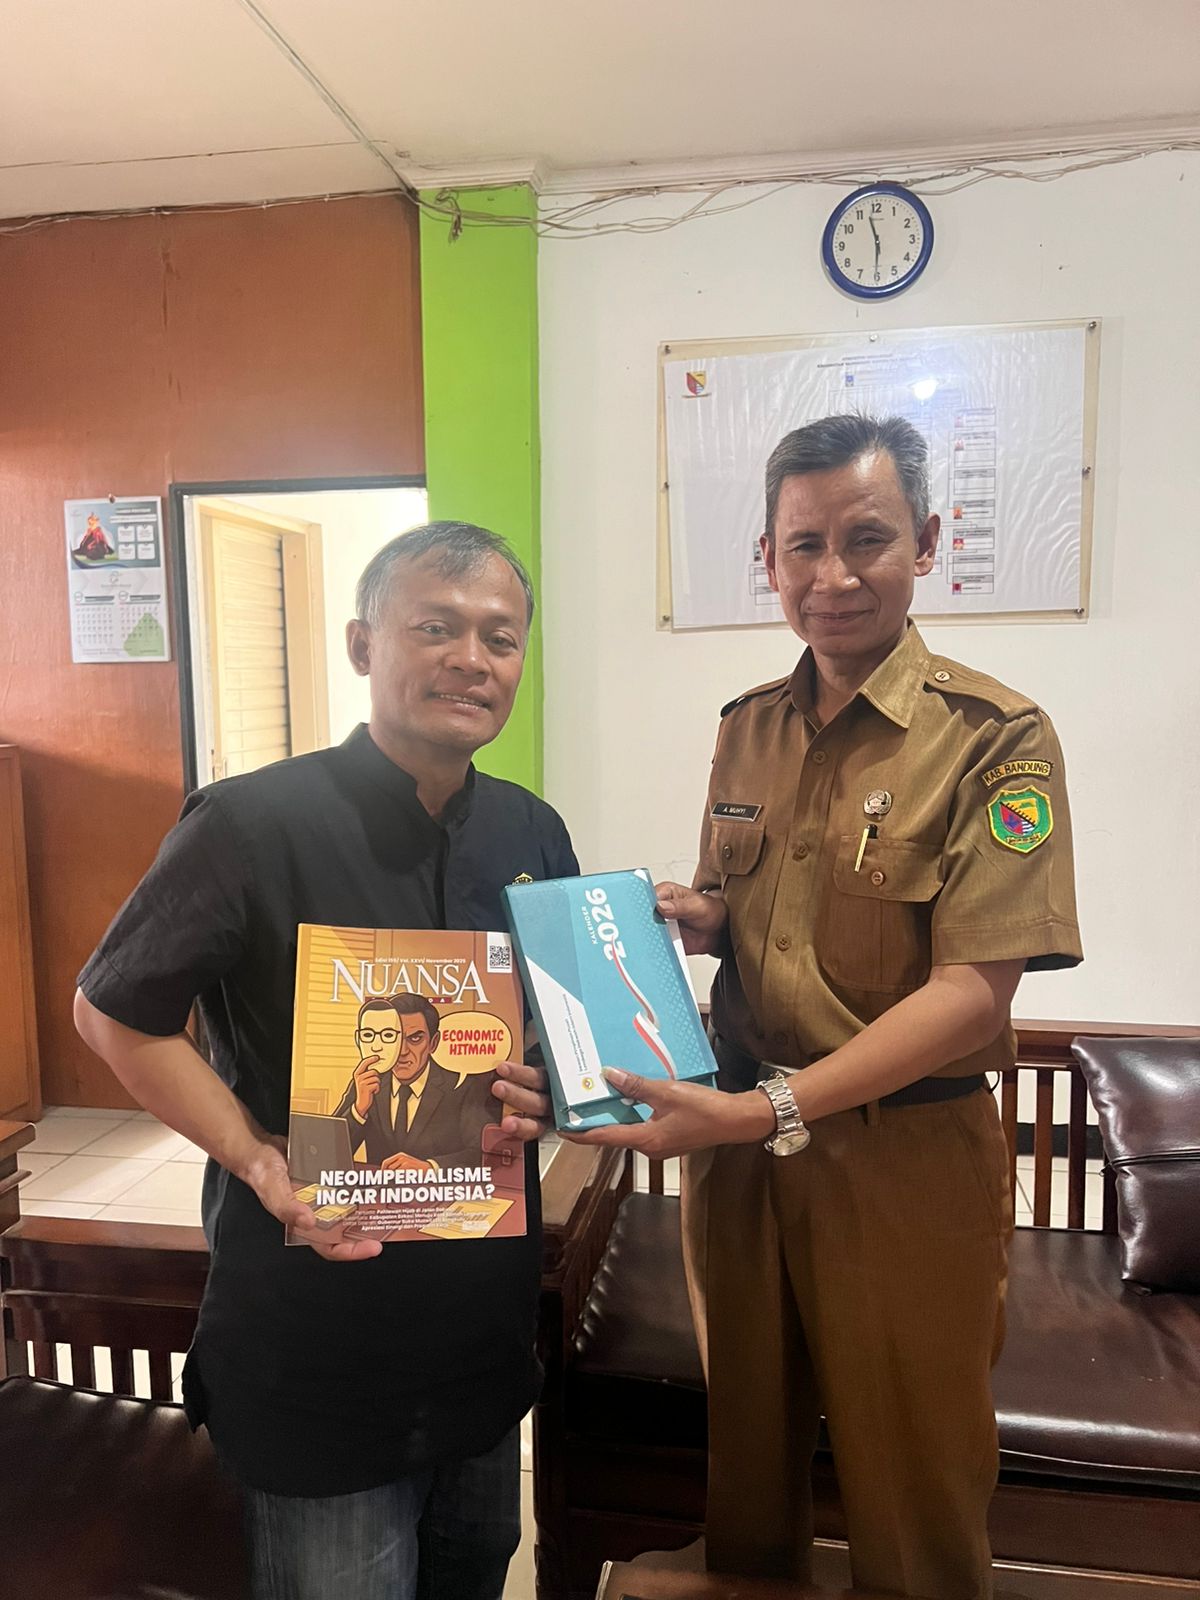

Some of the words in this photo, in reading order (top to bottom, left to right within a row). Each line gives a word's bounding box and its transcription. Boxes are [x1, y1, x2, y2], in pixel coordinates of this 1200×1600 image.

[871, 203, 882, 213] 12
[856, 210, 863, 220] 11
[904, 218, 910, 228] 2
[844, 224, 854, 234] 10
[909, 234, 916, 244] 3
[839, 242, 845, 251] 9
[904, 252, 910, 262] 4
[844, 258, 851, 268] 8
[857, 269, 864, 279] 7
[891, 266, 898, 275] 5
[874, 272, 880, 281] 6
[1004, 762, 1049, 774] BANDUNG
[581, 905, 598, 945] KALENDER
[584, 887, 627, 961] 2026
[330, 958, 490, 1004] NUANSA
[442, 1029, 504, 1042] ECONOMIC
[449, 1043, 496, 1056] HITMAN
[320, 1167, 492, 1187] NEOIMPERIALISME
[316, 1188, 375, 1206] INCAR
[380, 1183, 495, 1204] INDONESIA?
